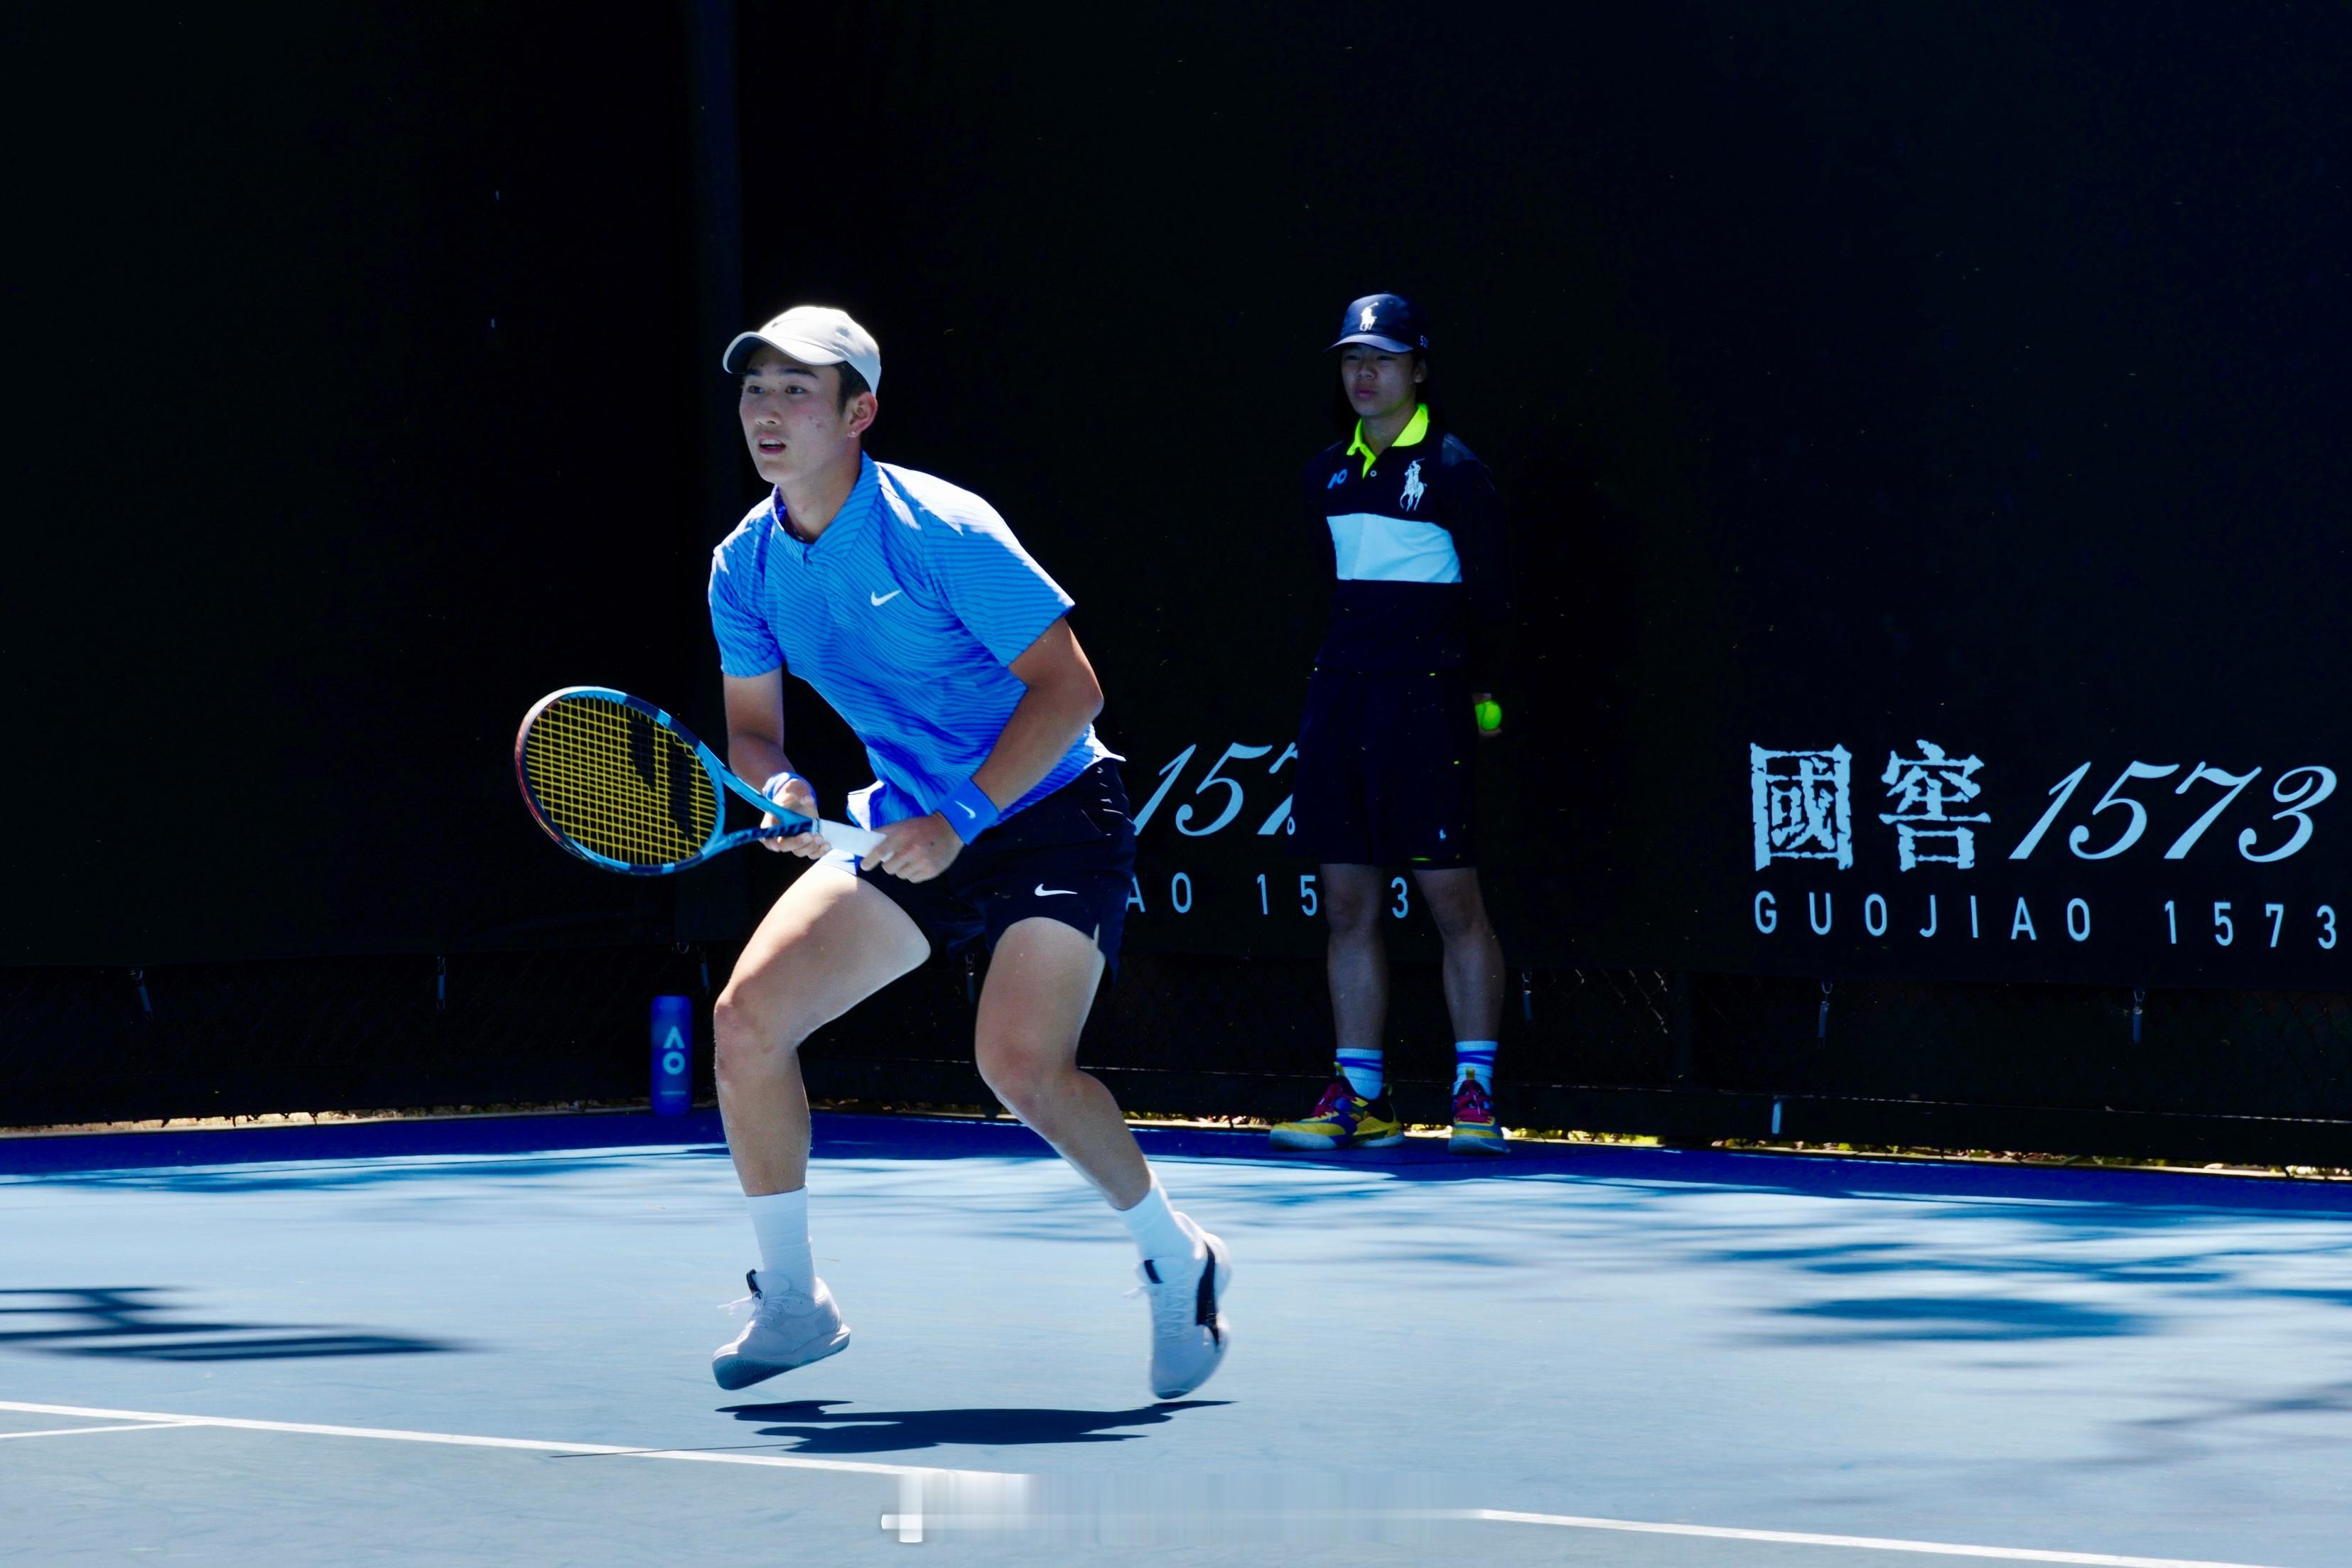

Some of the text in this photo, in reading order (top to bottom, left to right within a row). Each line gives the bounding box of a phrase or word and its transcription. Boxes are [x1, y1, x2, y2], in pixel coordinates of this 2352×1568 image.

[1749, 739, 2337, 872] 國窖 1573
[1257, 873, 1408, 919] 153
[1754, 890, 2337, 950] GUOJIAO 1573
